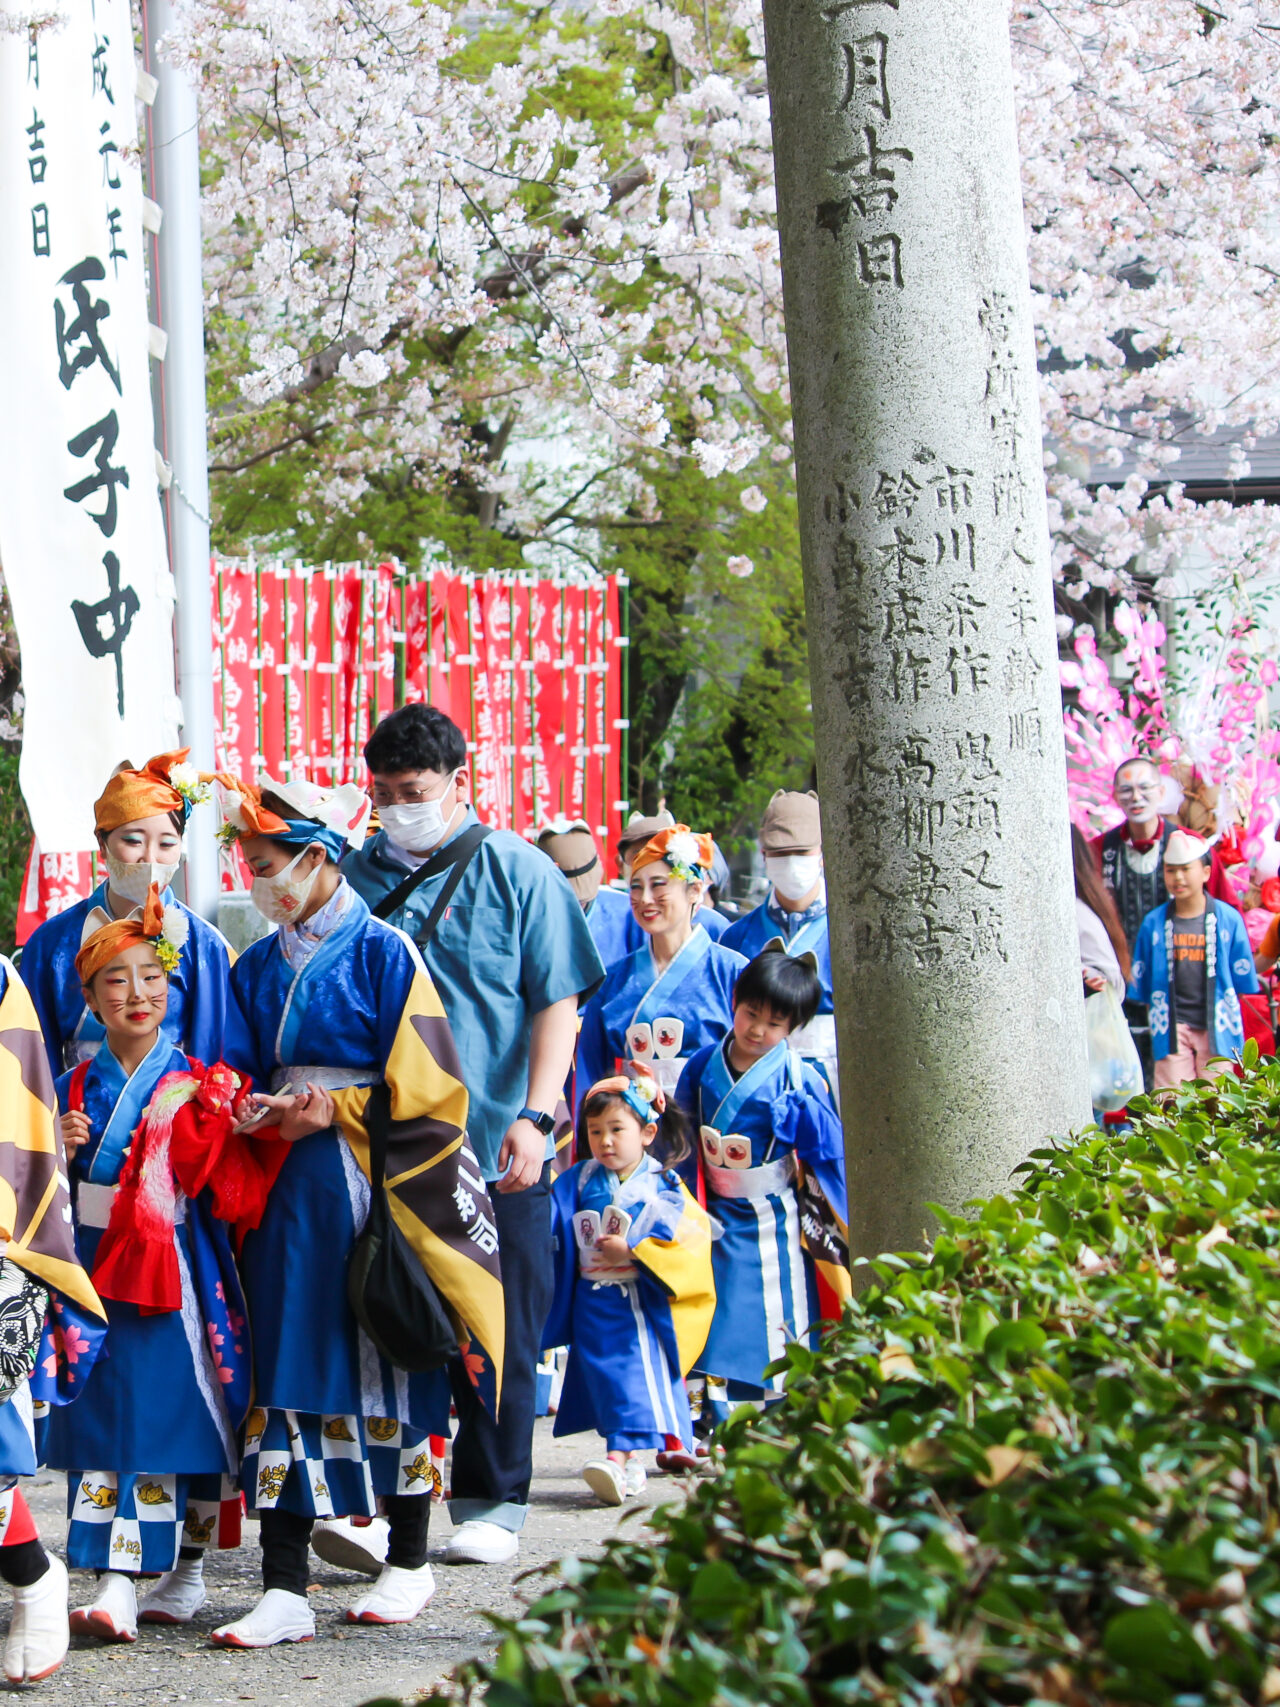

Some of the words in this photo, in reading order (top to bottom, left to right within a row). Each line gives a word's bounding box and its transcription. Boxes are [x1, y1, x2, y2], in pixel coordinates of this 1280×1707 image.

[91, 0, 128, 281] 成元年
[53, 256, 141, 721] 氏子中
